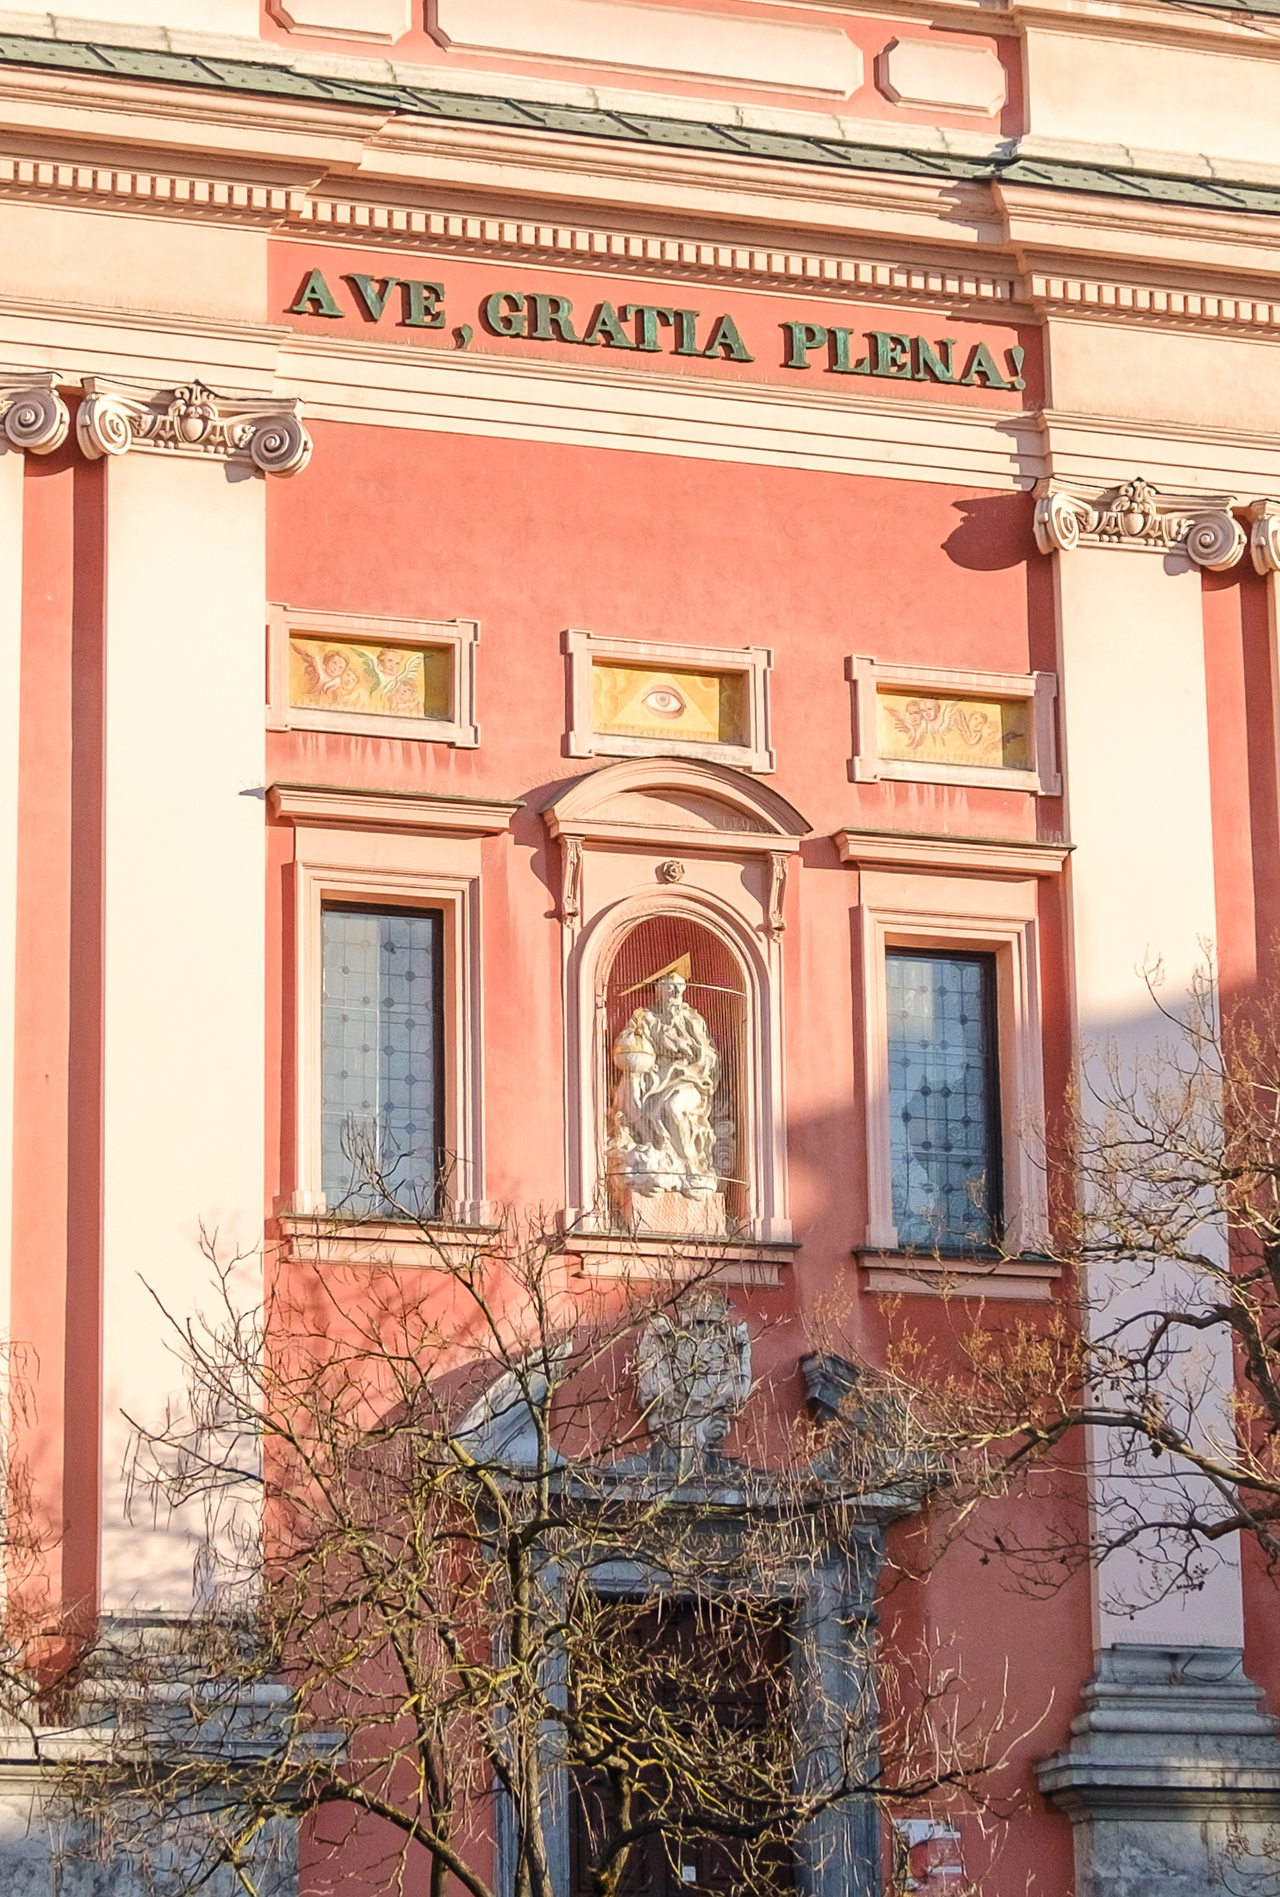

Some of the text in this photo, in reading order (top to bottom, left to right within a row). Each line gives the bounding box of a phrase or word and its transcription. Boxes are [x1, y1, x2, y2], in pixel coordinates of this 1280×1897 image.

[284, 267, 1026, 392] AVE, GRATIA PLENA!
